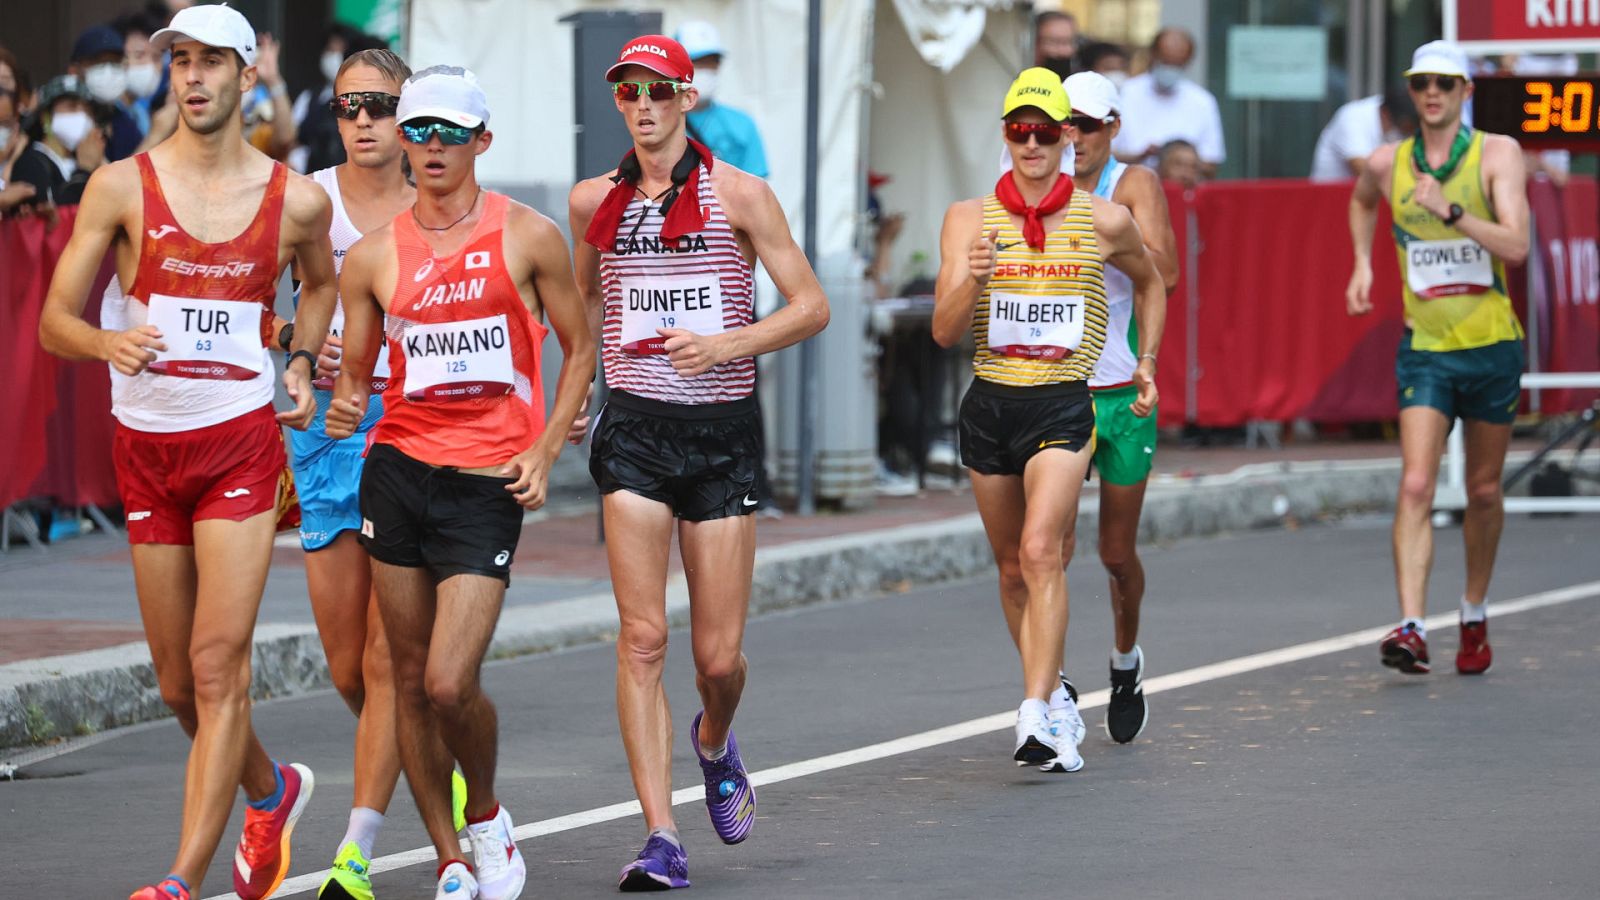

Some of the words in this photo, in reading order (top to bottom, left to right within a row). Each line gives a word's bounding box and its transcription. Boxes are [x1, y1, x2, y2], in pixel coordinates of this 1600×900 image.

[620, 43, 668, 61] CANADA
[1521, 81, 1600, 133] 3:0
[1411, 246, 1482, 267] COWLEY
[160, 257, 255, 279] ESPAÑA
[994, 263, 1082, 278] GERMANY
[629, 286, 712, 312] DUNFEE
[181, 308, 230, 335] TUR
[996, 300, 1077, 323] HILBERT
[661, 317, 675, 328] 19
[1030, 327, 1042, 337] 76
[196, 340, 211, 351] 63
[407, 325, 505, 358] KAWANO
[446, 361, 467, 373] 125
